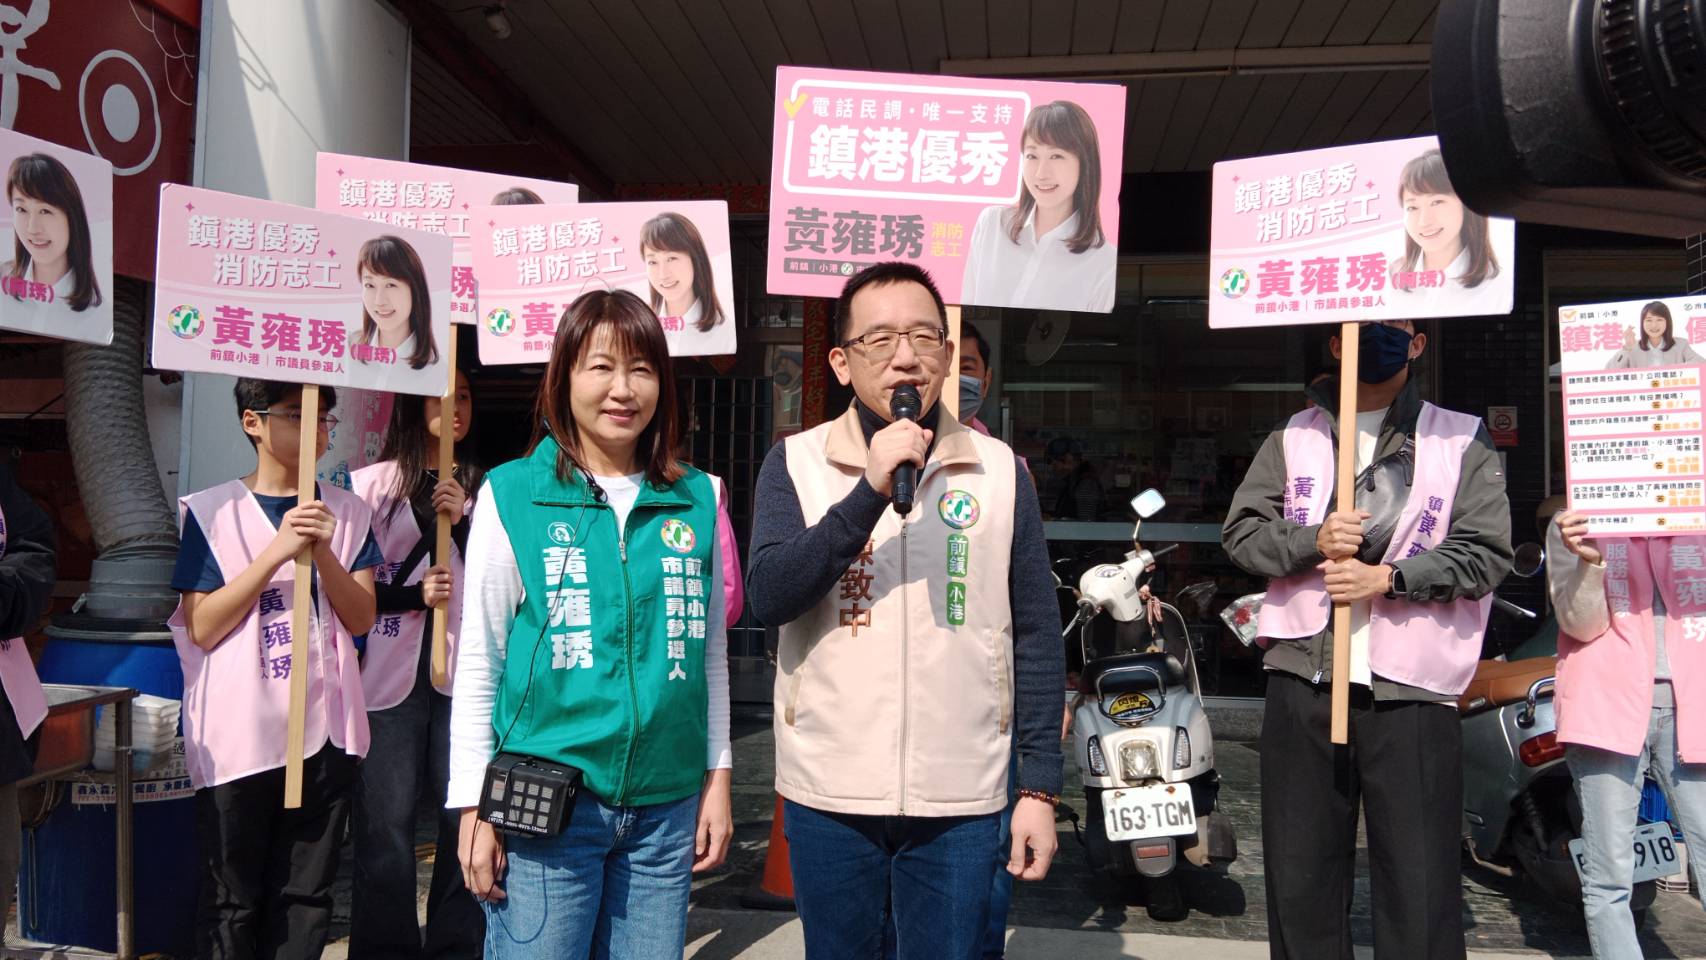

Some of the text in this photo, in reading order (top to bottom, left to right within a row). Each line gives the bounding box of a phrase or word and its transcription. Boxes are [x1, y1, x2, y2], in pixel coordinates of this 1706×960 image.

[808, 124, 1009, 186] 鎮港優秀
[339, 178, 455, 209] 鎮港優秀
[1234, 161, 1357, 214] 鎮港優秀
[187, 214, 320, 255] 鎮港優秀
[493, 218, 604, 257] 鎮港優秀
[784, 206, 925, 260] 黃雍琇
[931, 221, 964, 239] 消防
[1257, 193, 1381, 243] 消防志工
[517, 247, 628, 286] 消防志工
[931, 240, 962, 257] 志工
[213, 253, 343, 290] 消防志工
[1257, 252, 1387, 300] 黃雍琇
[1255, 295, 1386, 314] 前鎮小港 市議員參選人
[211, 305, 346, 359] 黃雍琇
[1562, 322, 1624, 353] 鎮港
[210, 348, 345, 374] 前鎮小港 市議員參選人
[685, 557, 706, 639] 前鎮小港
[949, 538, 969, 620] 前鎮 小港
[543, 546, 594, 670] 黃雍琇
[661, 557, 687, 681] 市議員參選人
[1633, 836, 1676, 870] 918
